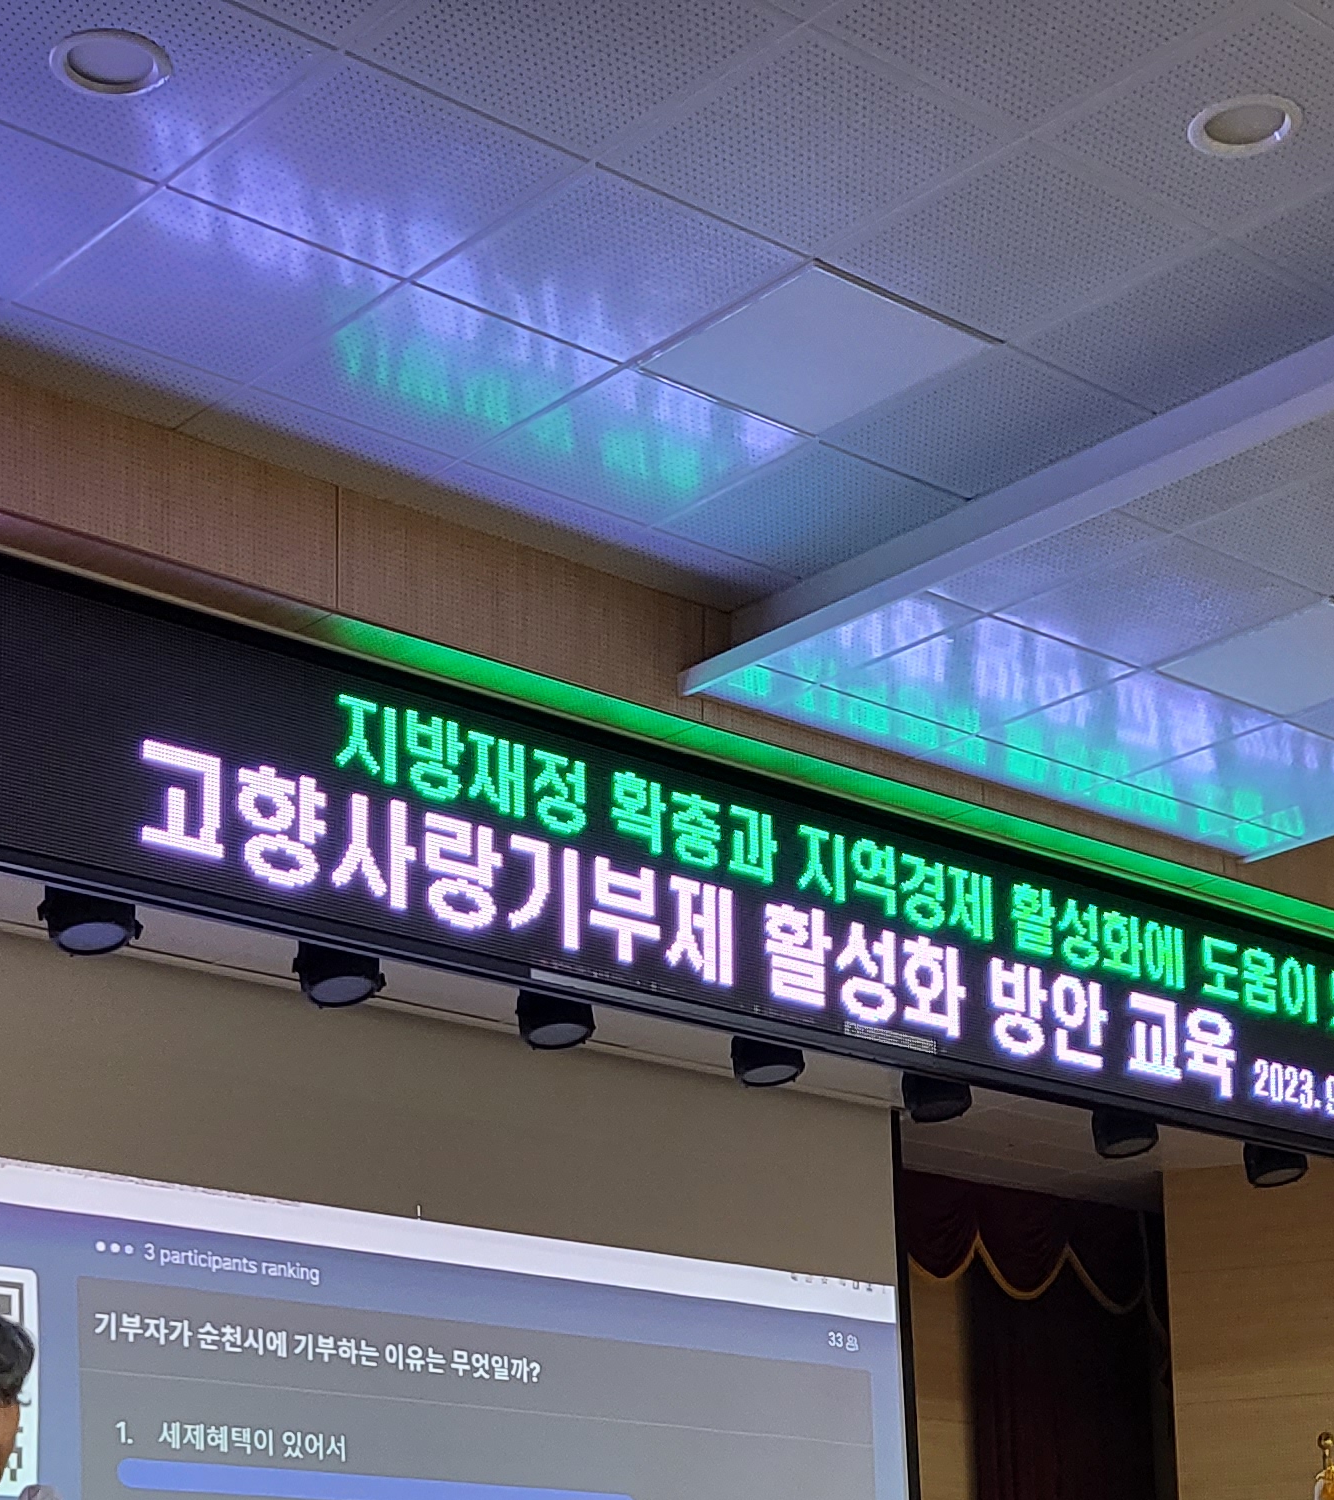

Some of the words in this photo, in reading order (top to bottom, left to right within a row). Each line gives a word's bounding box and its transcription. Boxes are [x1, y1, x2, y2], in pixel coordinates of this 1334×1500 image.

[335, 693, 588, 834] 지방재정
[609, 769, 779, 885] 확충과
[798, 824, 994, 942] 지역경제
[1010, 881, 1186, 991] 활성화에
[1201, 935, 1318, 1026] 도움이
[139, 738, 736, 989] 고향사랑기부제
[765, 903, 966, 1039] 활성화
[988, 955, 1110, 1070] 방안
[1127, 990, 1238, 1100] 교육
[144, 1242, 156, 1261] 3
[160, 1246, 258, 1274] participants
[261, 1260, 321, 1286] ranking
[93, 1311, 193, 1348] 기부자가
[196, 1321, 288, 1359] 순천시에
[293, 1331, 380, 1367] 기부하는
[385, 1343, 447, 1375] 이유는
[450, 1350, 542, 1384] 무엇일까?
[827, 1330, 844, 1348] 33
[115, 1420, 134, 1445] 1.
[157, 1420, 275, 1458] 세제혜택이
[281, 1429, 348, 1463] 있어서
